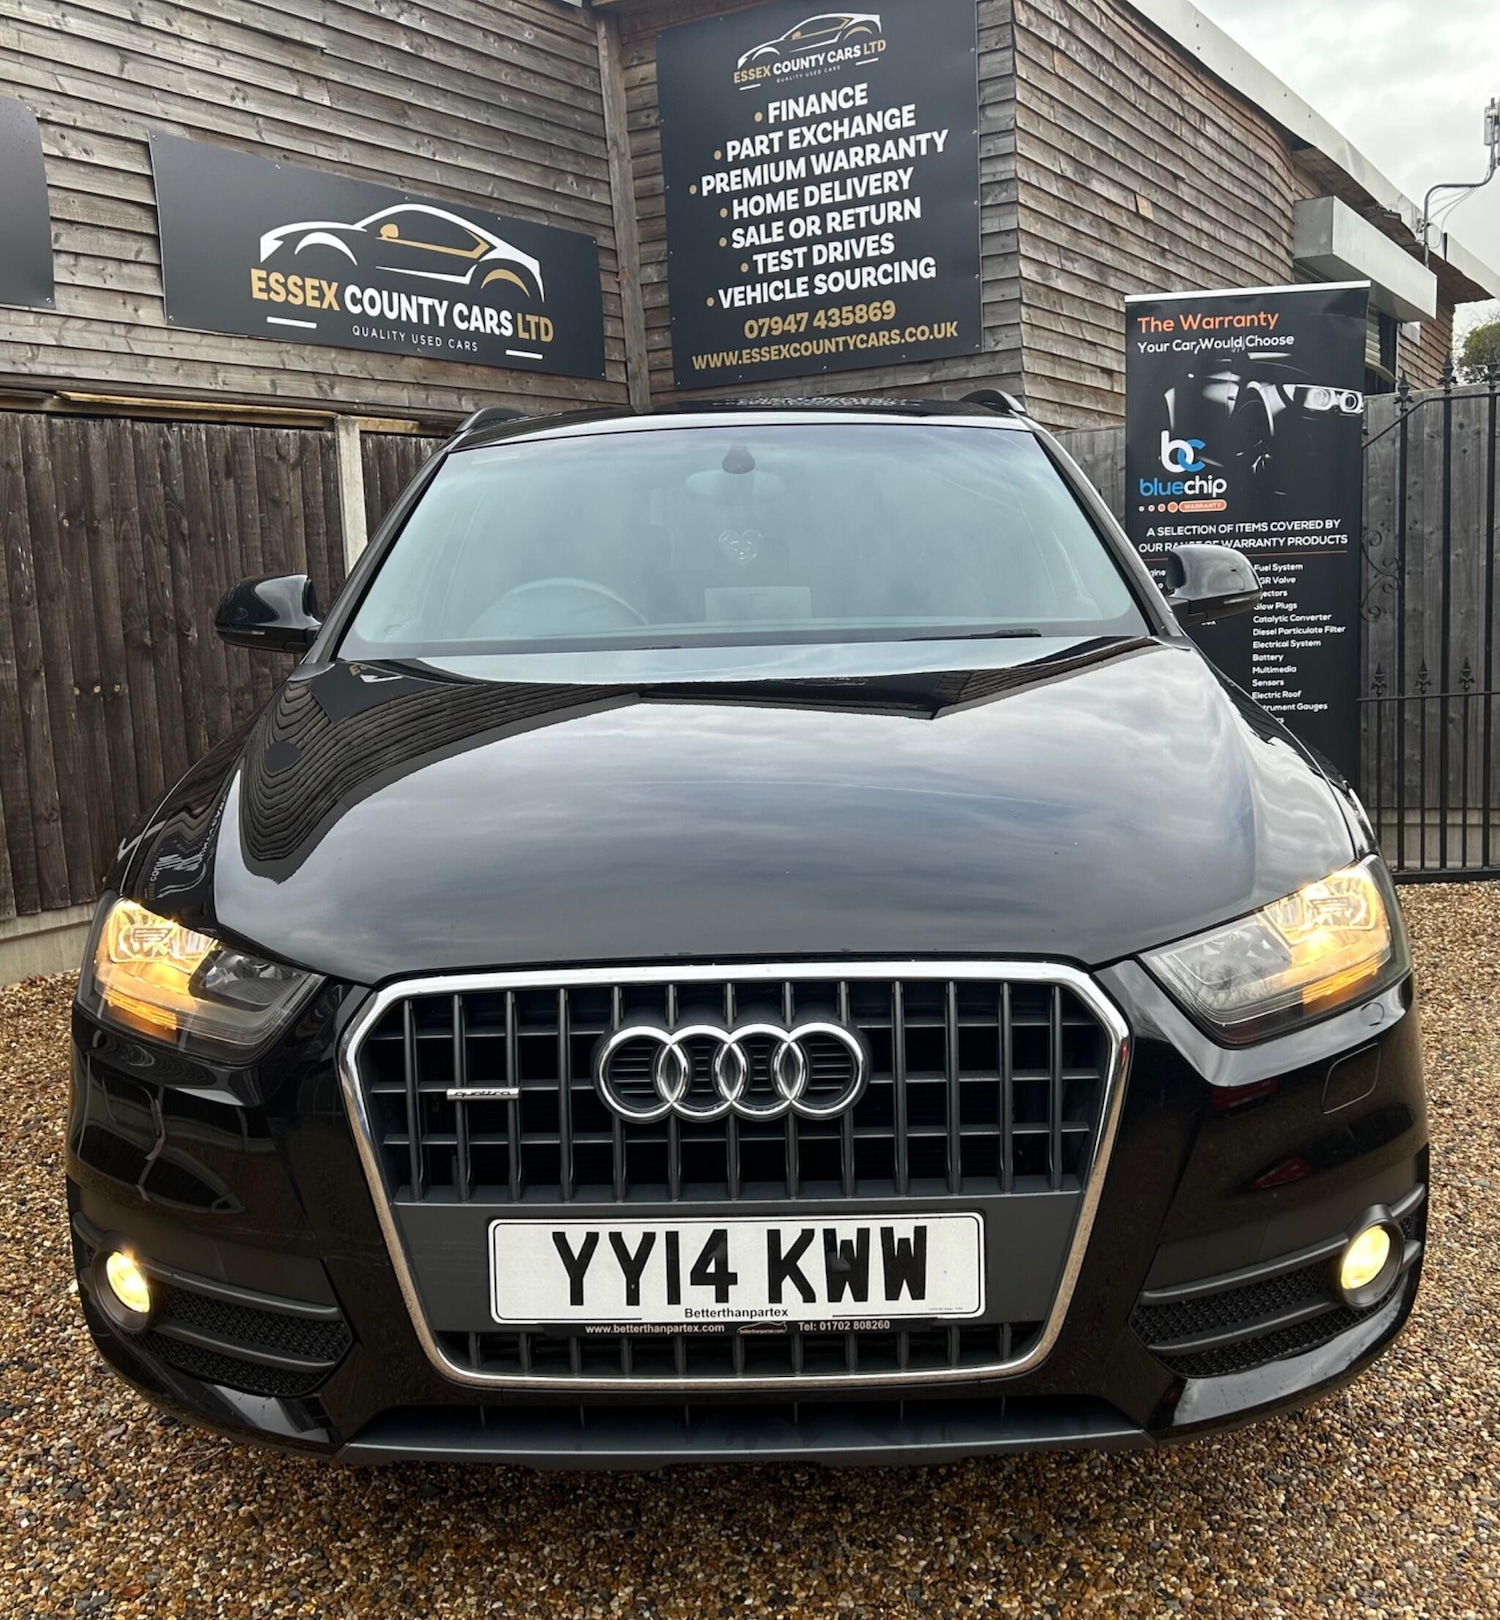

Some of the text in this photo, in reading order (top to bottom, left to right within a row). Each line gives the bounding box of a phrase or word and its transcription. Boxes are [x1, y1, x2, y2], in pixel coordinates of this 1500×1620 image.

[733, 40, 887, 84] ESSEX COUNTY CARS LTD
[776, 65, 841, 84] QUALITY USED CARS
[768, 83, 868, 124] FINANCE
[726, 103, 916, 162] PART EXCHANGE
[701, 129, 949, 196] PREMIUM WARRANTY
[732, 166, 914, 220] HOME DELIVERY
[731, 196, 922, 249] SALE OR RETURN
[752, 232, 895, 275] TEST DRIVES
[718, 256, 936, 309] VEHICLE SOURCING
[250, 268, 554, 342] ESSEX COUNTY CARS LTD
[744, 300, 896, 340] 07947 435869
[1137, 311, 1279, 334] The Warranty
[352, 325, 478, 352] QUALITY USED CARS
[692, 321, 959, 370] WWW.ESSEXCOUNTYCARS.CO.UK
[1137, 341, 1170, 354] Your
[1199, 336, 1243, 350] Would
[1245, 334, 1295, 347] Choose
[1140, 475, 1227, 497] bluechip
[1183, 502, 1222, 510] WARRANTY
[1146, 519, 1341, 537] A SELECTION OF ITEMS COVERED BY
[1138, 543, 1163, 553] OUR
[1221, 537, 1286, 549] WARRANTY
[1287, 534, 1348, 546] PRODUCTS
[1253, 563, 1303, 572] Fuel System
[1259, 576, 1297, 584] GR Valve
[1260, 590, 1288, 600] jectors
[1275, 602, 1298, 611] Plugs
[1253, 614, 1332, 624] Catalytic Converter
[1253, 625, 1346, 636] Diesel Particulate Filter
[1252, 639, 1321, 649] Electrical System
[1252, 653, 1284, 662] Battery
[1252, 665, 1297, 674] Multimedia
[1252, 679, 1285, 687] Sensors
[1252, 690, 1302, 699] Electric Roof
[1262, 703, 1328, 712] trument Gauges
[551, 1226, 928, 1306] YY14 KWW
[684, 1307, 788, 1320] Betterthanpartex
[585, 1322, 725, 1334] www.betterthanpartex.com
[798, 1322, 817, 1332] Tel:
[819, 1321, 851, 1331] 01702
[853, 1320, 891, 1330] 808260
